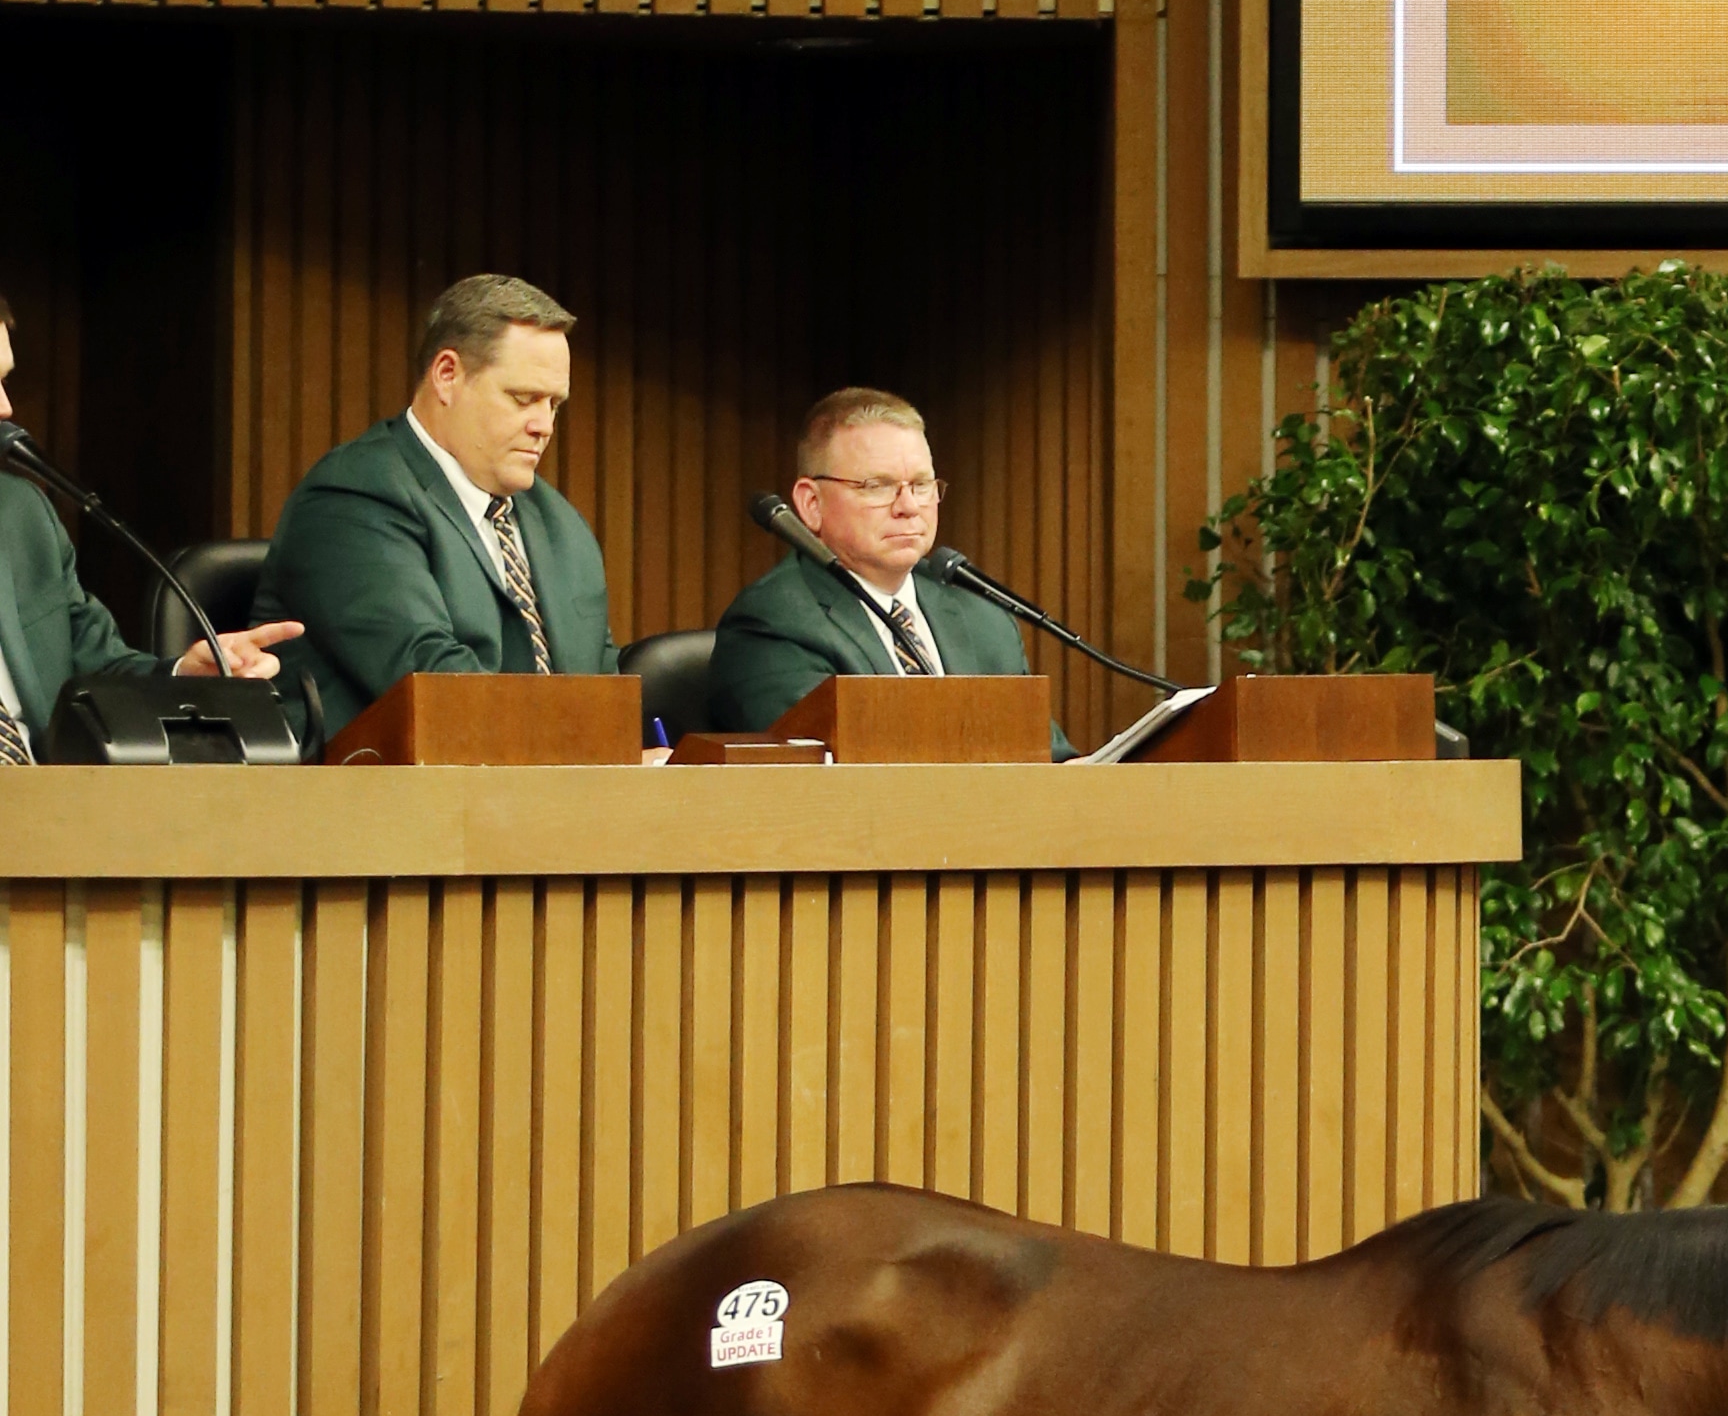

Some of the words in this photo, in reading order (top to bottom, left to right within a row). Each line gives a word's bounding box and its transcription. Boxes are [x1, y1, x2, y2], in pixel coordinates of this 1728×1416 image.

[723, 1289, 782, 1320] 475
[720, 1328, 764, 1344] Grade
[716, 1342, 777, 1362] UPDATE
